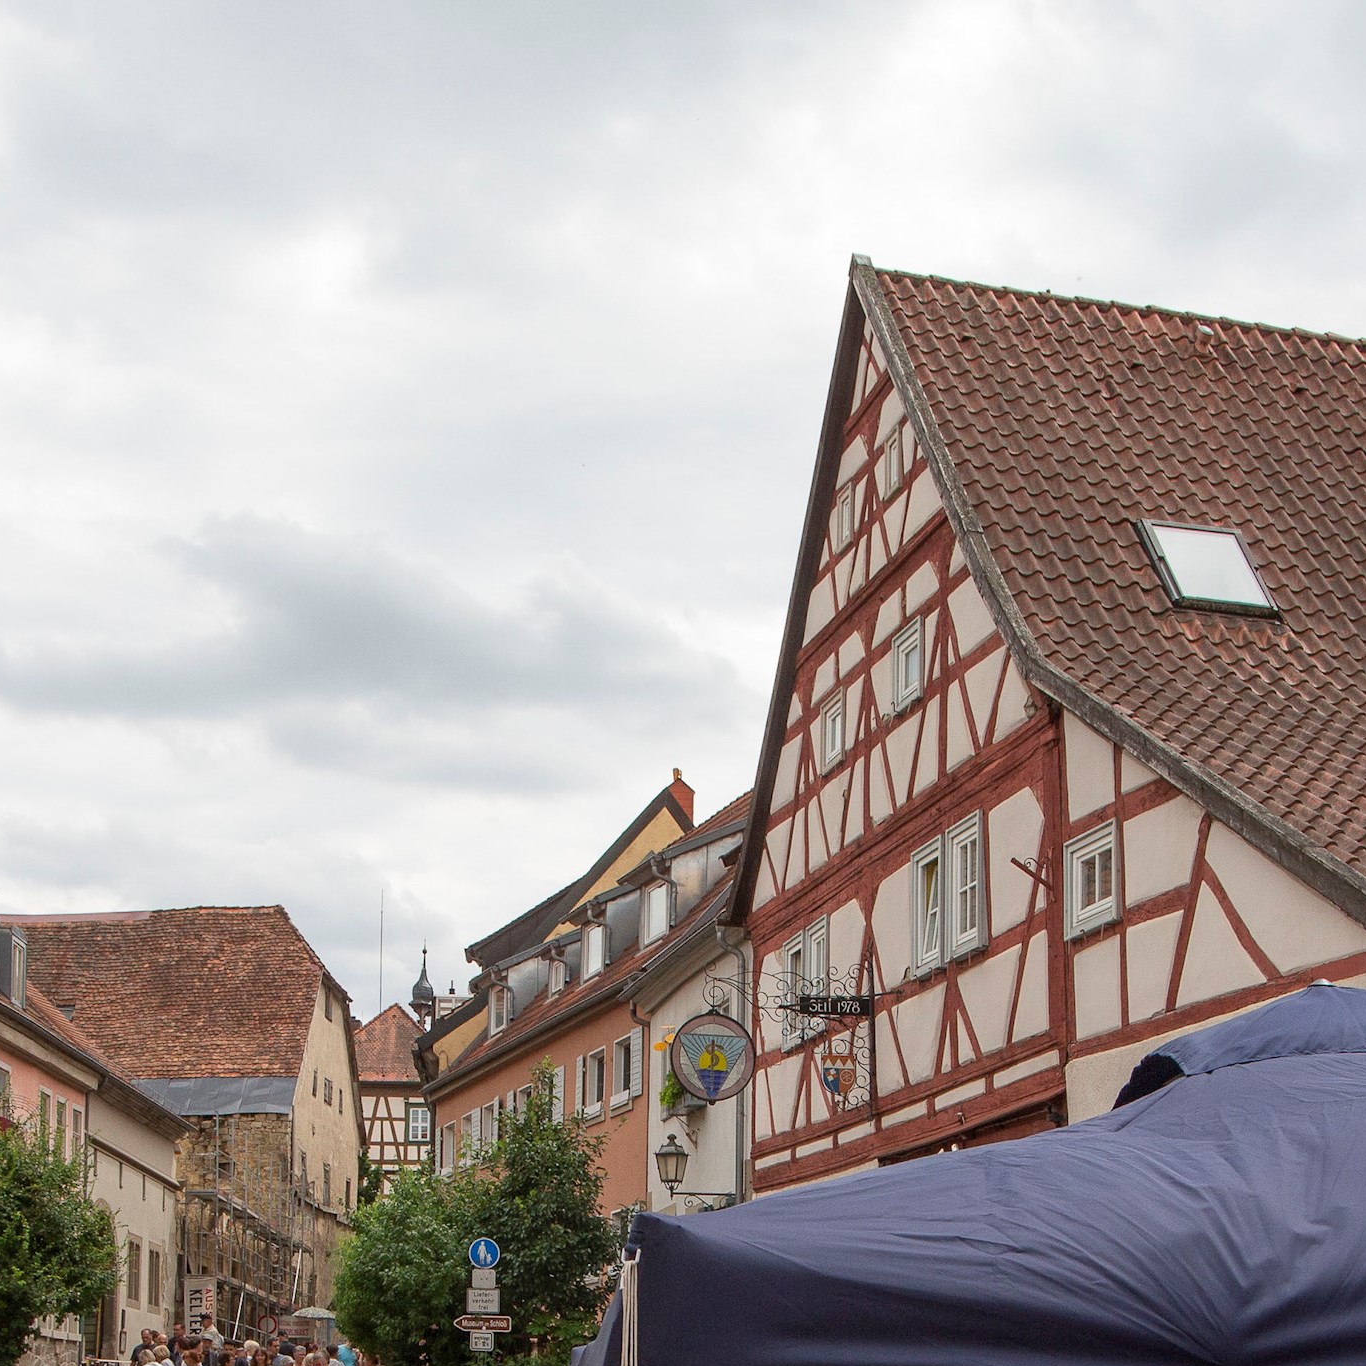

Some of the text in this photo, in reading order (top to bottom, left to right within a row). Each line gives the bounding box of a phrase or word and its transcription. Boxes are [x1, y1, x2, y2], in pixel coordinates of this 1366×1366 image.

[837, 1001, 861, 1014] 1978
[189, 1289, 203, 1335] KELTER
[461, 1319, 484, 1327] Museum
